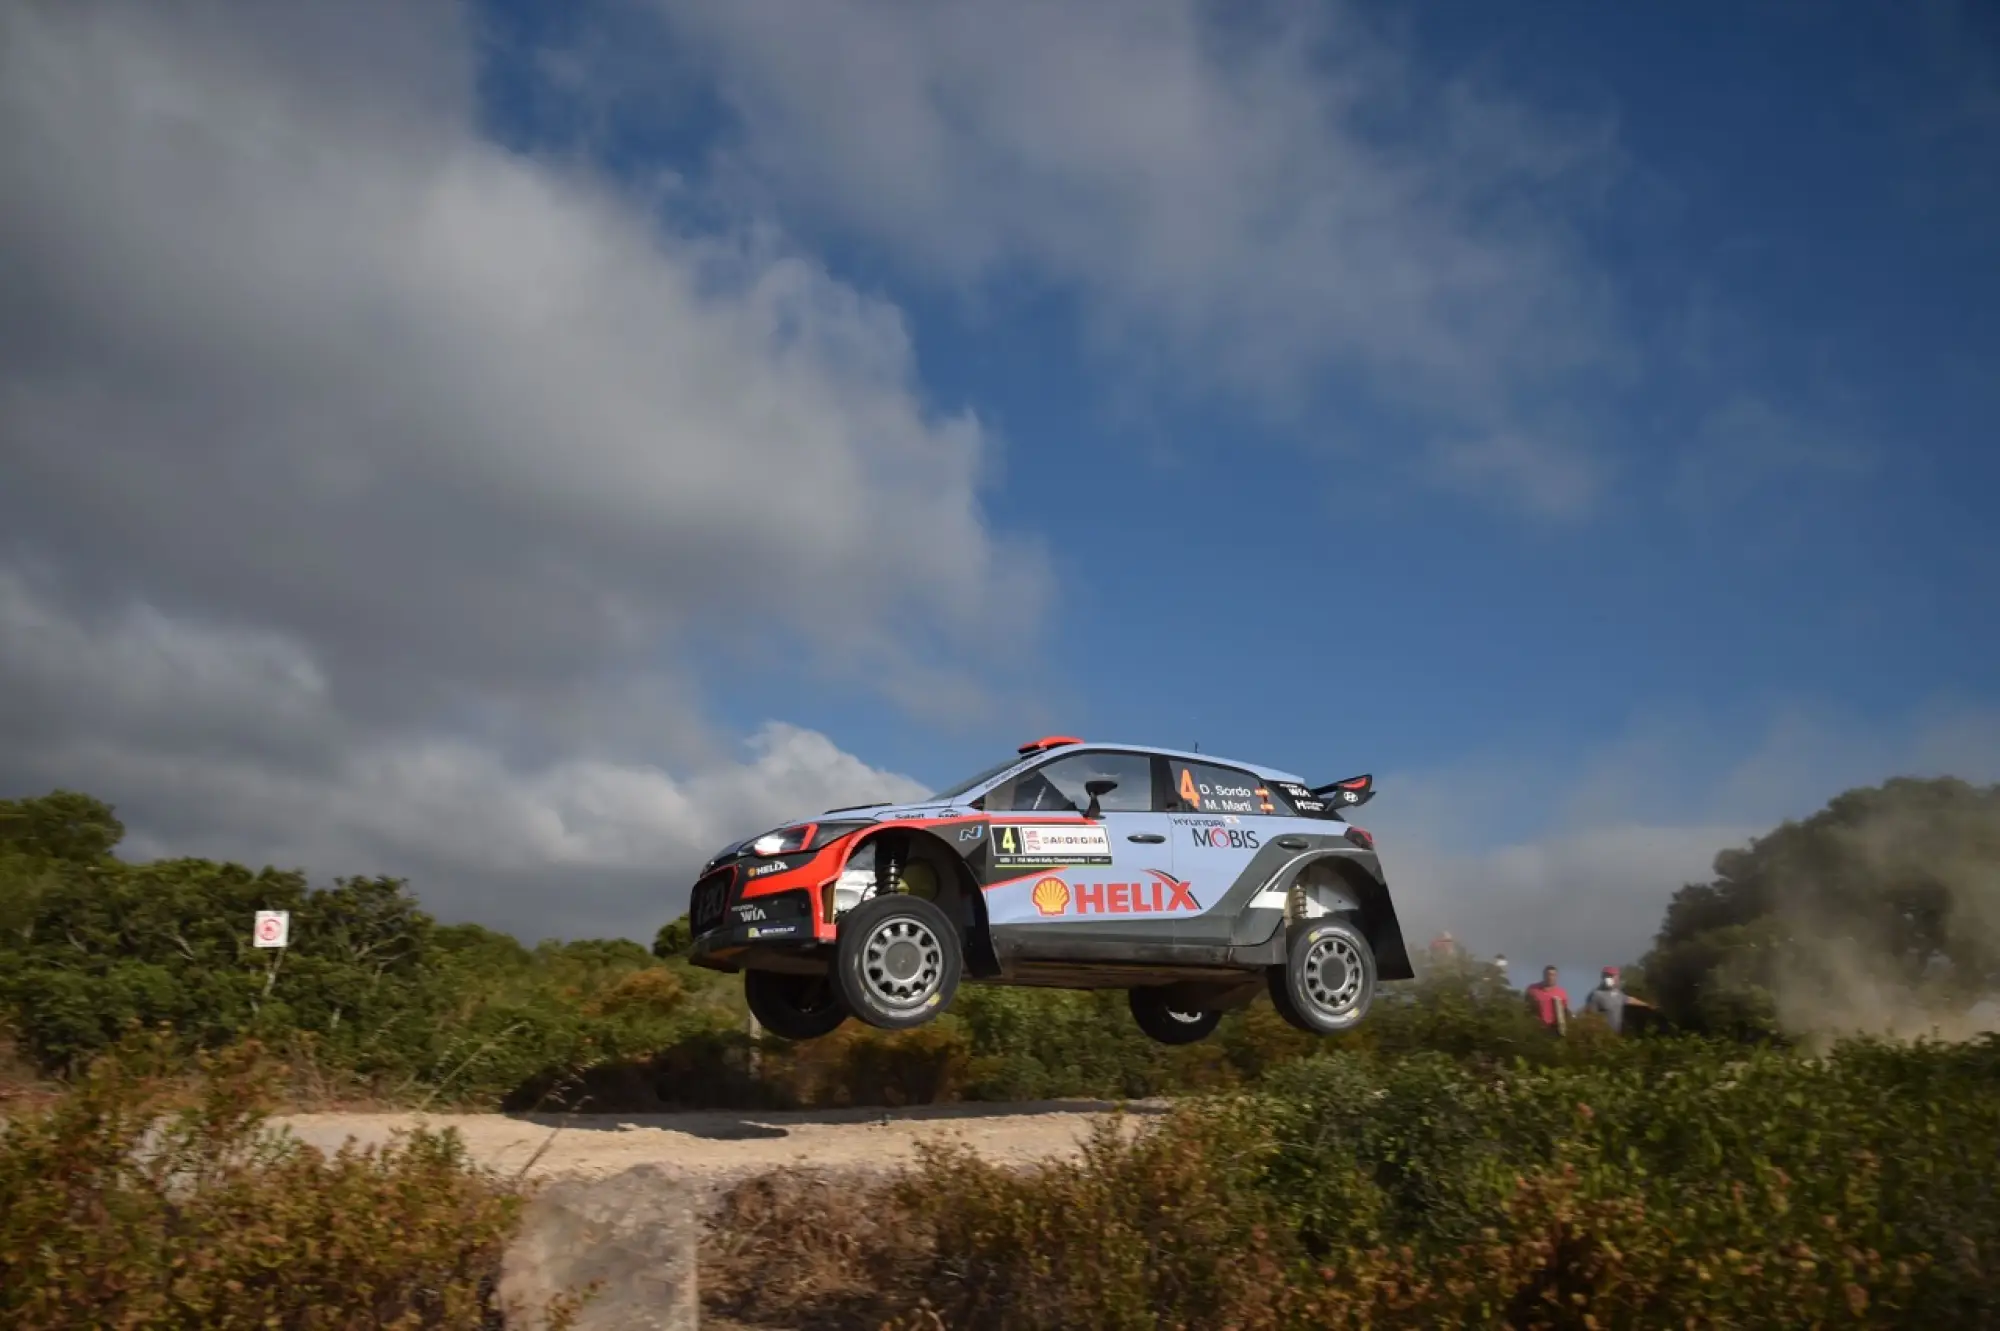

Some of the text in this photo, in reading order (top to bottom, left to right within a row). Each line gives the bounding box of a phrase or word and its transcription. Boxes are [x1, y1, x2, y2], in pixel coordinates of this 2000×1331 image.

[1180, 769, 1200, 809] 4
[1200, 784, 1251, 797] D. Sordo
[1204, 800, 1221, 810] M.
[1002, 827, 1016, 854] 4
[1042, 836, 1105, 845] SARDEGNA
[1191, 828, 1260, 849] MOBIS
[756, 861, 788, 876] HELIX
[1073, 869, 1202, 914] HELIX
